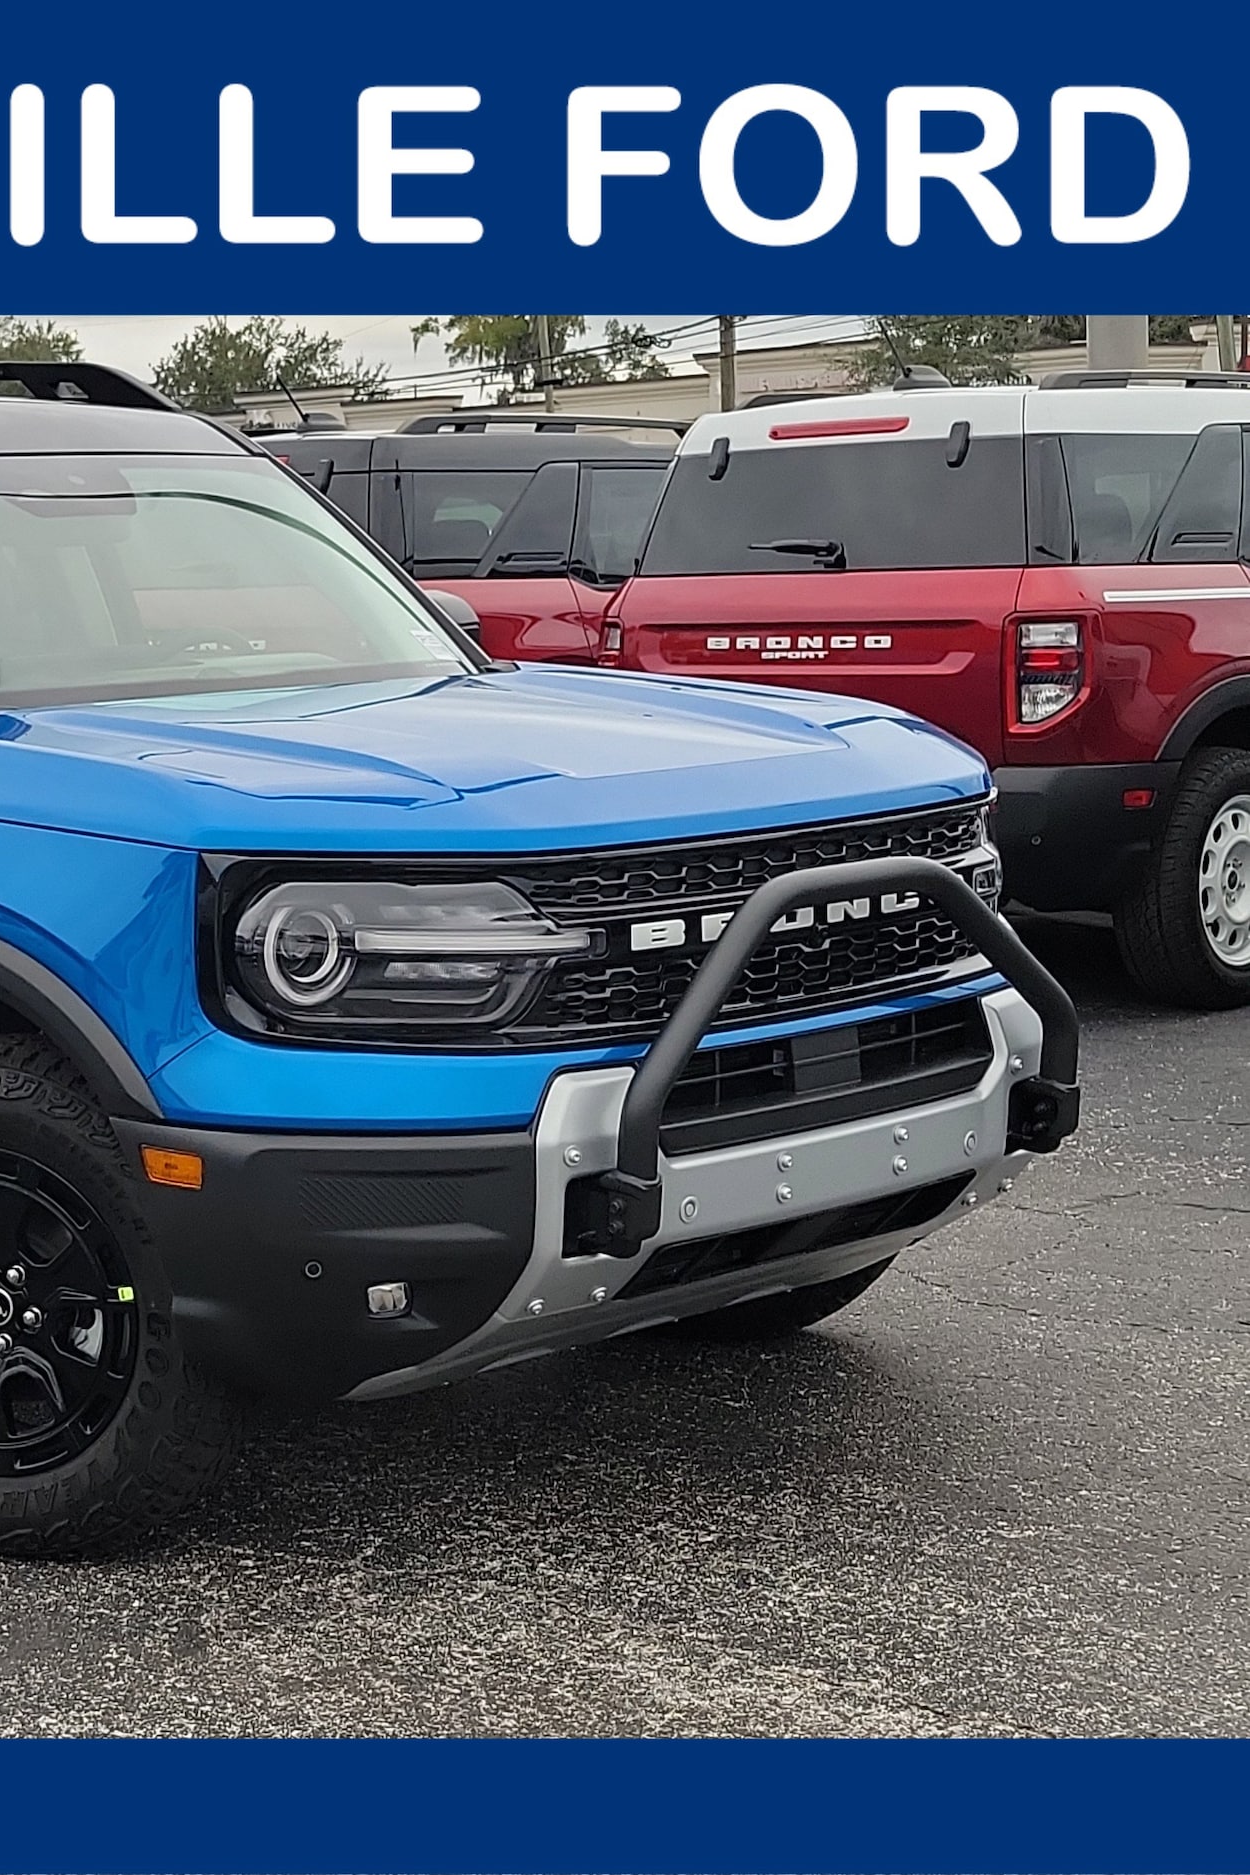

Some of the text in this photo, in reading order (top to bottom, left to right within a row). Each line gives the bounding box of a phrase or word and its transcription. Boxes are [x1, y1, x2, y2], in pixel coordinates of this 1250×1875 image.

[706, 635, 892, 649] BRONCO
[761, 650, 829, 659] SPORT
[630, 892, 936, 951] BRONC
